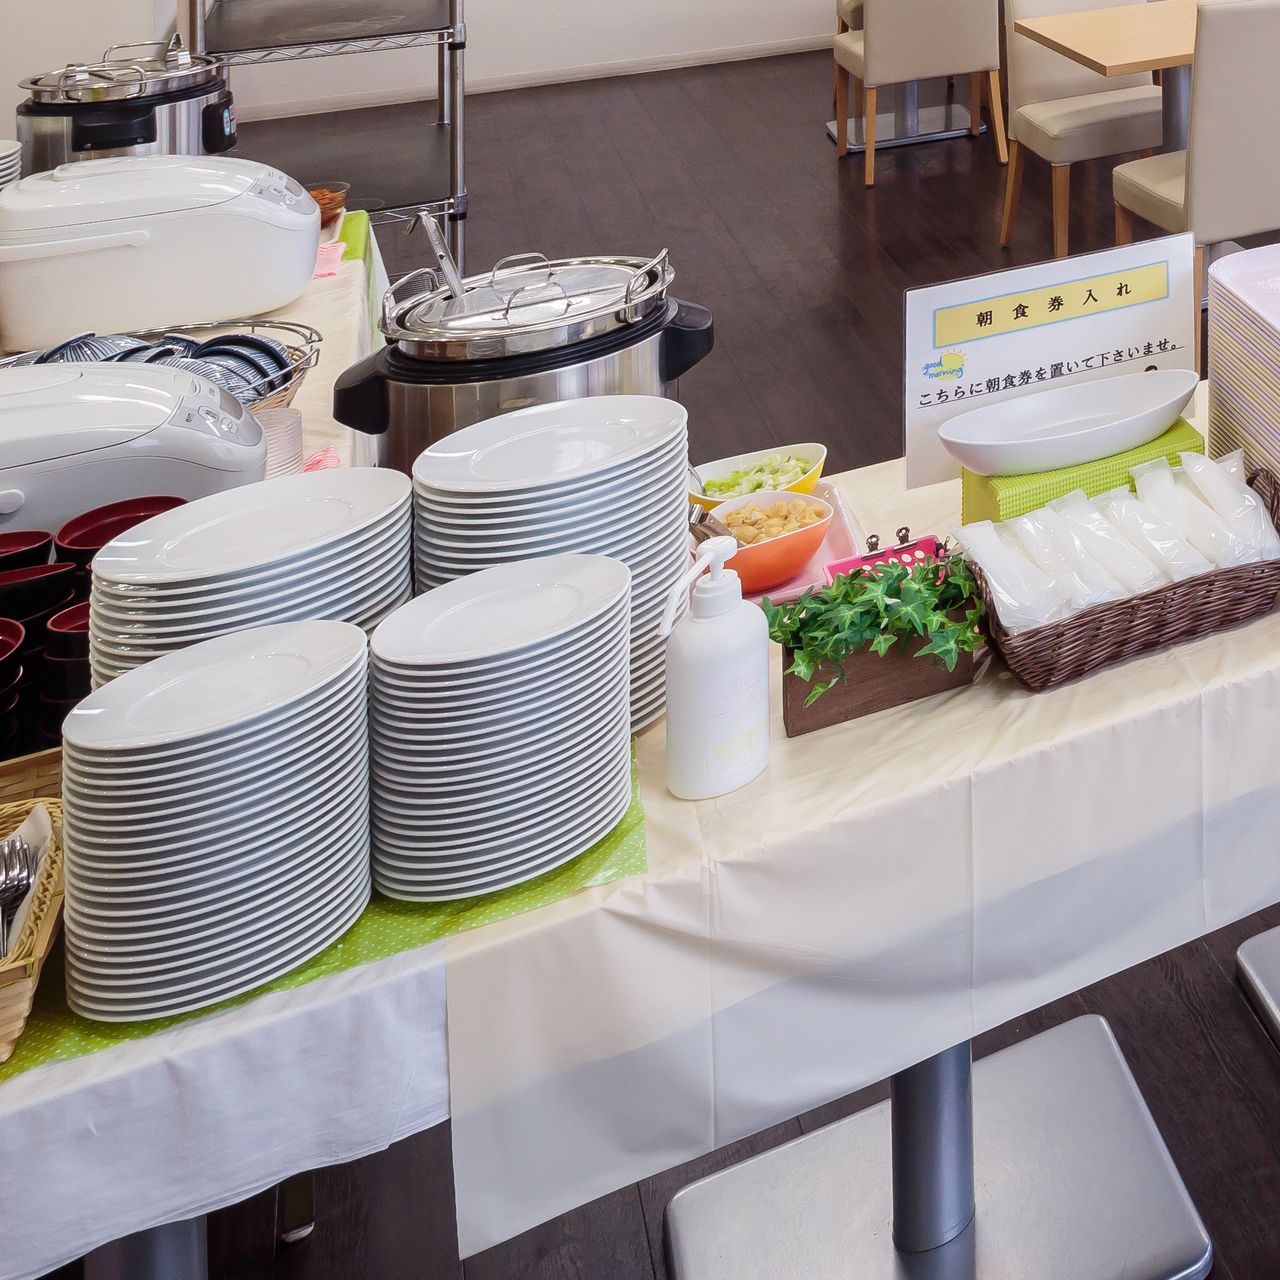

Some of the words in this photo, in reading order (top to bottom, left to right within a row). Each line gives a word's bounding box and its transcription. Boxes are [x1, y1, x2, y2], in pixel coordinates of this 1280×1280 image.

[975, 281, 1132, 328] 朝食券入れ
[918, 337, 1178, 407] こちらに朝食券を置いて下さいませ。
[922, 355, 944, 376] good
[928, 364, 964, 380] morning
